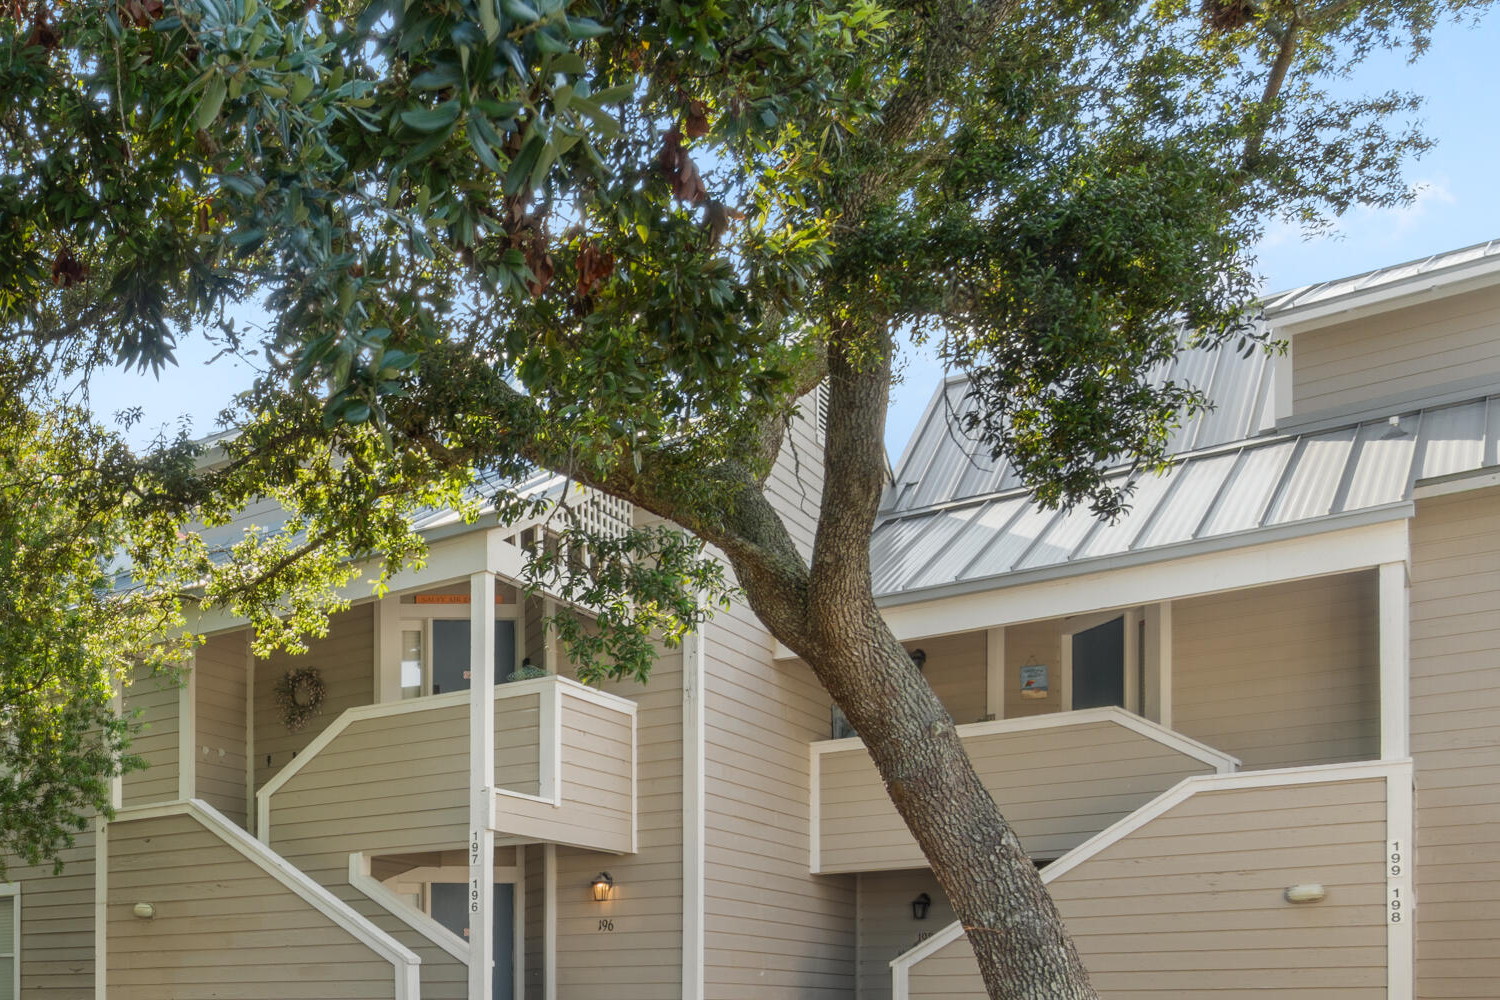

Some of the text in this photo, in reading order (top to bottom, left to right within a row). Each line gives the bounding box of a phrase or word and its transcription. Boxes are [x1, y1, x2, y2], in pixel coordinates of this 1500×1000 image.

[1391, 841, 1401, 876] 199
[1391, 888, 1401, 923] 198
[598, 919, 614, 932] 196
